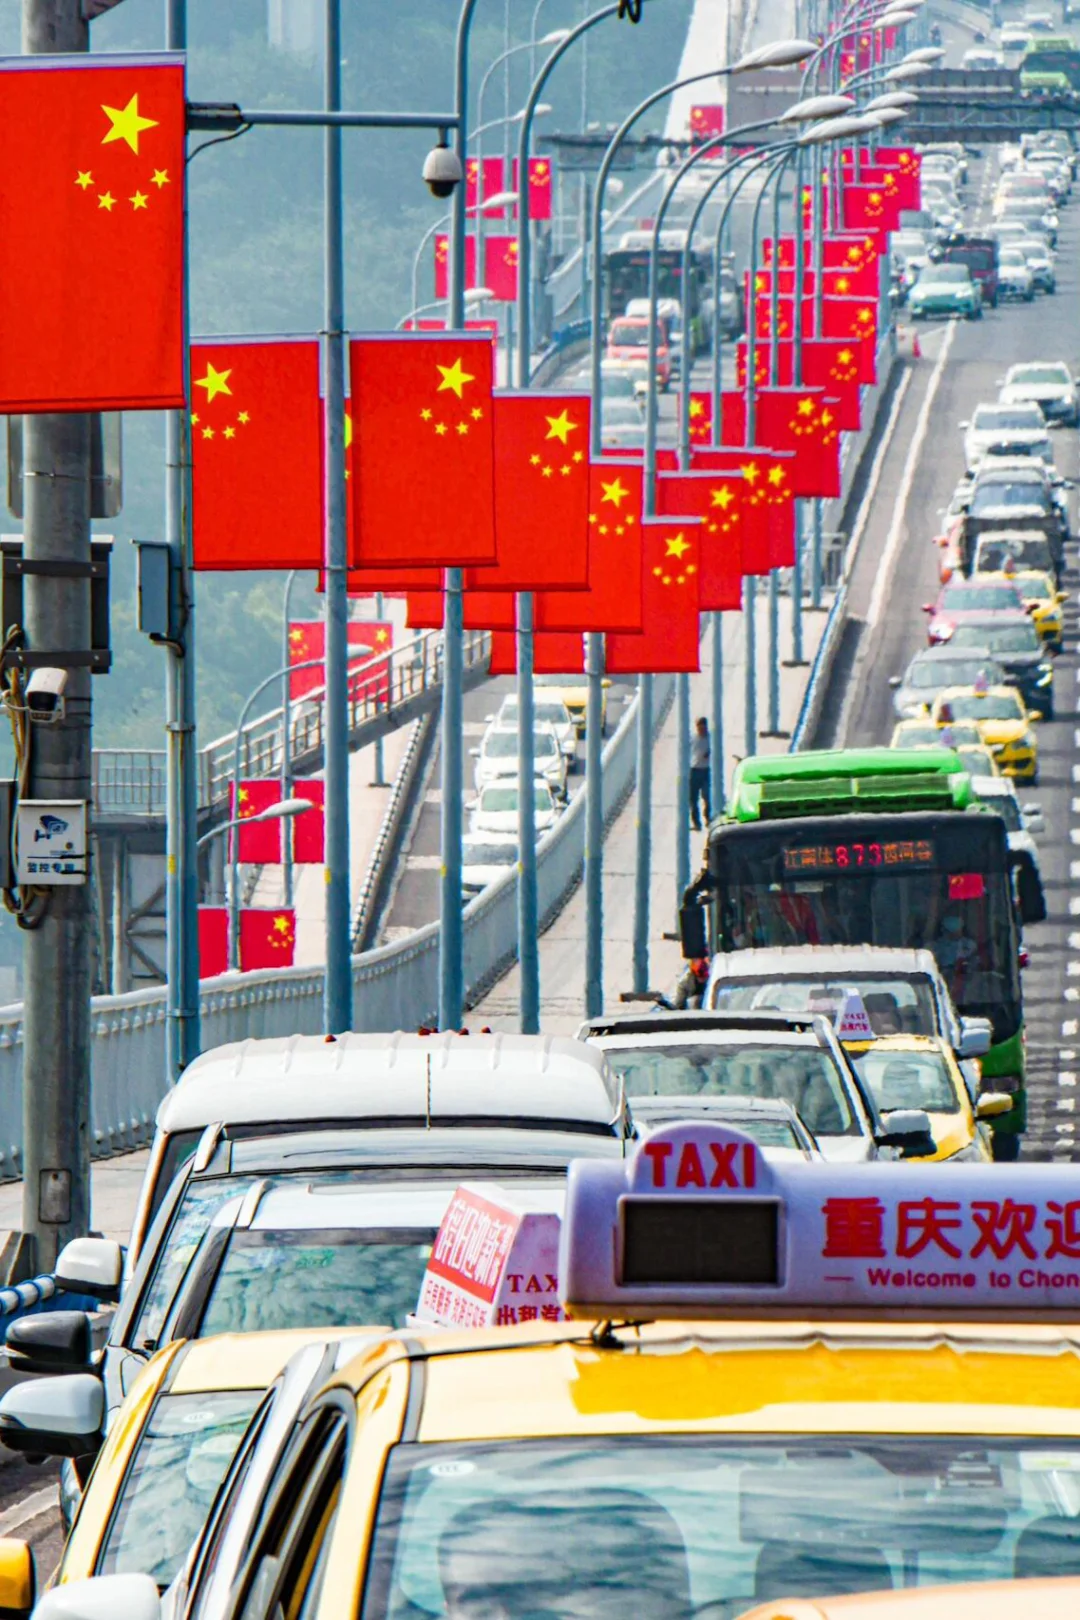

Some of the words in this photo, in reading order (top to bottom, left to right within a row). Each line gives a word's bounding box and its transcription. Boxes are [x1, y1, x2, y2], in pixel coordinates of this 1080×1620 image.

[835, 843, 882, 867] 873
[644, 1142, 756, 1188] TAXI
[867, 1268, 976, 1288] Welcome
[990, 1270, 1010, 1287] to
[1018, 1269, 1080, 1288] Chon
